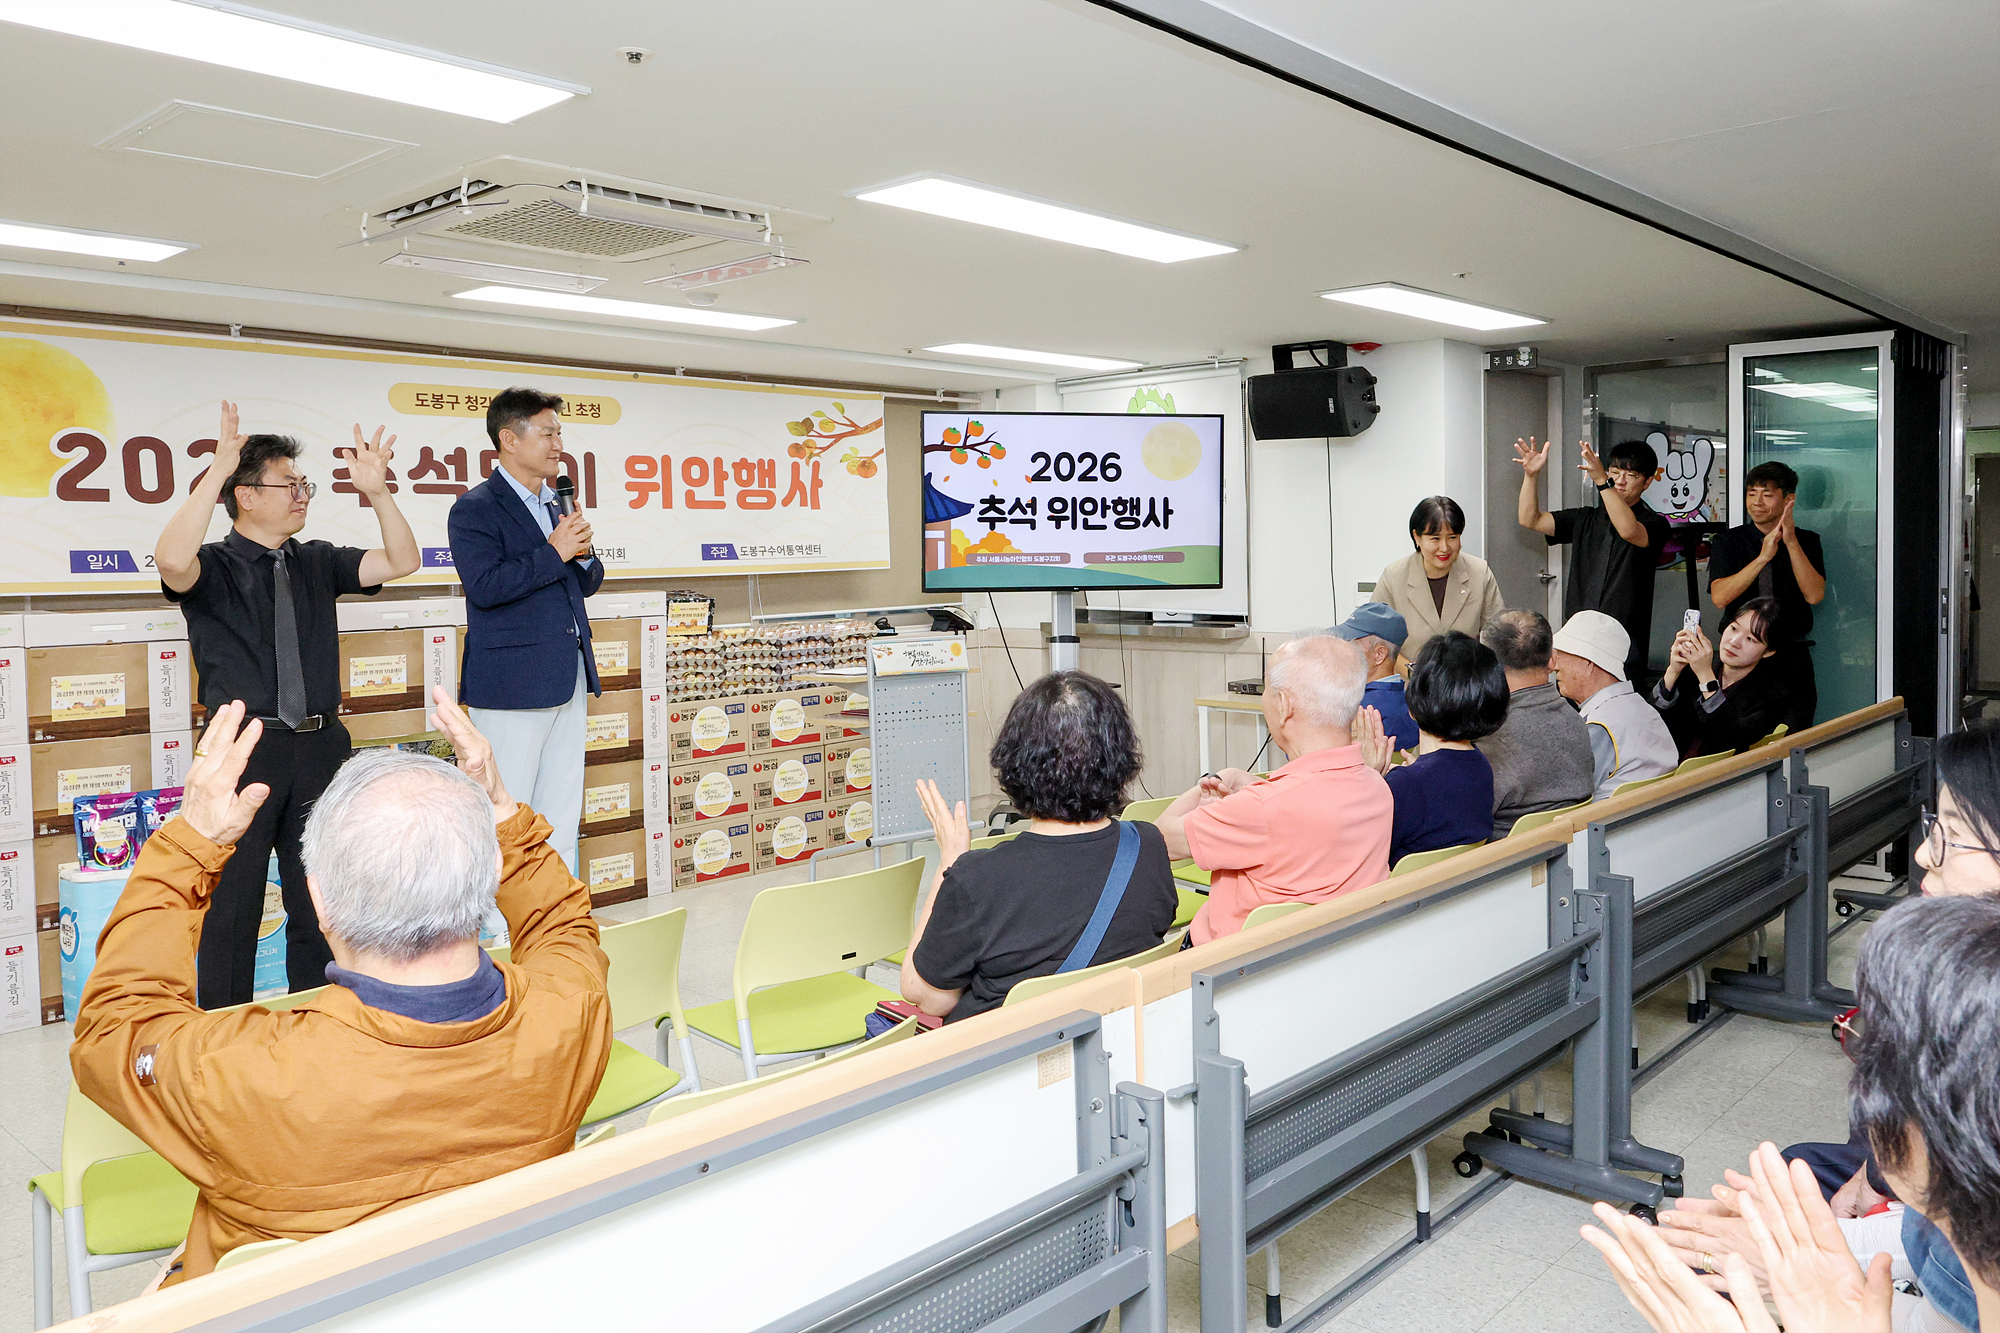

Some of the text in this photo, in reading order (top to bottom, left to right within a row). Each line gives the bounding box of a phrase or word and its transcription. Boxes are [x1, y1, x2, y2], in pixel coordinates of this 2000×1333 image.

[414, 392, 461, 411] 도봉구
[575, 401, 602, 419] 초청
[624, 453, 824, 511] 위안행사
[1029, 450, 1123, 483] 2026
[976, 494, 1173, 531] 추석 위안행사
[86, 553, 119, 571] 일시
[709, 542, 822, 559] 주관 도봉구수어통역센터
[160, 664, 173, 708] 들기름김
[163, 753, 176, 788] 들기름
[683, 775, 700, 784] 농심
[763, 762, 778, 771] 농심
[0, 865, 14, 912] 들기름김
[6, 960, 20, 1006] 들기름김
